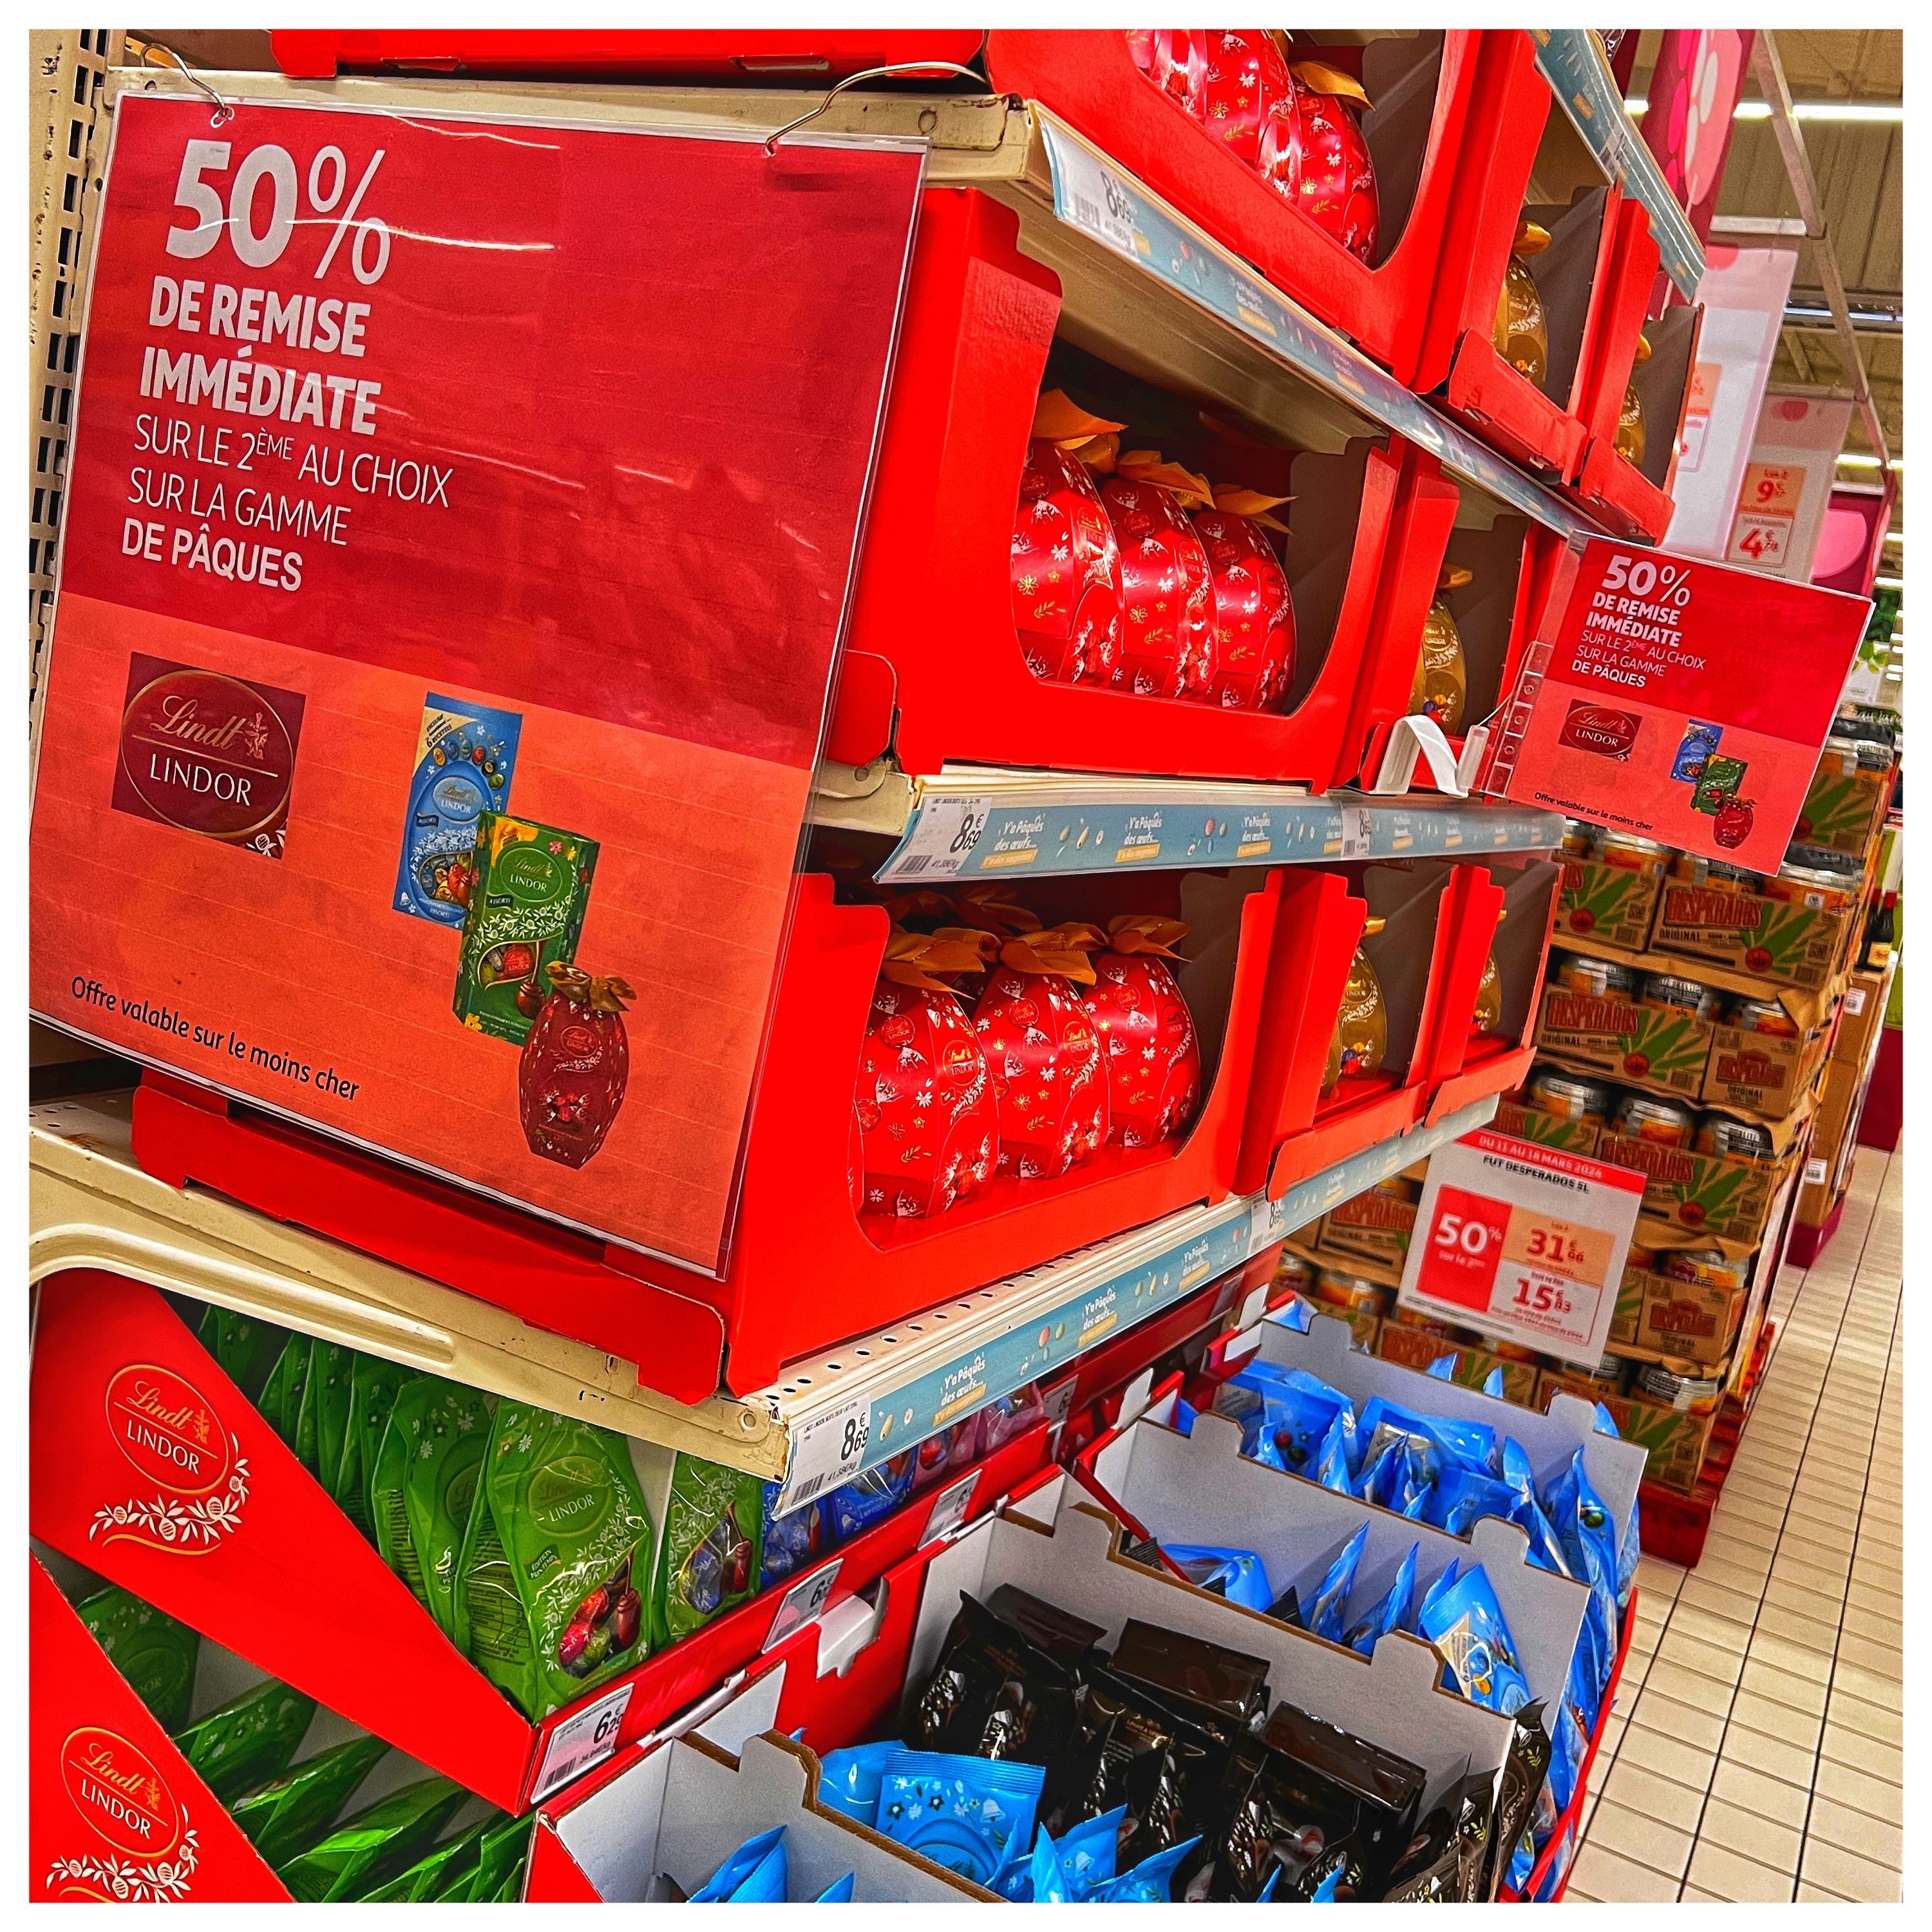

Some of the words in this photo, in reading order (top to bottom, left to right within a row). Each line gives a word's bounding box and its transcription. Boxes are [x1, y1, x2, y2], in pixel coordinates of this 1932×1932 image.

[166, 139, 391, 285] 50%
[149, 276, 201, 330] DE
[209, 284, 372, 357] REMISE
[140, 345, 382, 435] IMMÉDIATE
[134, 414, 191, 459] SUR
[197, 424, 232, 466] LE
[237, 428, 295, 471] 2ÈME
[298, 444, 345, 486] AU
[352, 453, 453, 507] CHOIX
[128, 467, 185, 512] SUR
[191, 478, 226, 521] LA
[235, 488, 352, 545] GAMME
[122, 517, 166, 561] DE
[171, 523, 303, 592] PÂQUES
[1602, 554, 1691, 606] 50%
[1593, 591, 1616, 610] DE
[1616, 597, 1680, 625] REMISE
[1586, 611, 1682, 647] IMMÉDIATE
[1577, 645, 1601, 661] SUR
[1602, 652, 1617, 665] LA
[1620, 656, 1667, 676] GAMME
[1581, 630, 1605, 645] SUR
[1607, 636, 1622, 650] LE
[1647, 647, 1666, 659] AU
[1667, 652, 1707, 670] CHOIX
[1572, 659, 1591, 674] DE
[1592, 664, 1646, 688] PÂQUES
[149, 696, 247, 750] Lindt
[1575, 729, 1618, 746] LINDOR
[1578, 712, 1618, 730] Lindt
[150, 753, 252, 806] LINDOR
[440, 799, 471, 814] LINDOR
[1534, 791, 1555, 804] Offre
[1556, 799, 1586, 812] valable
[1586, 808, 1600, 816] sur
[1601, 810, 1609, 819] le
[1609, 814, 1634, 826] moins
[1636, 821, 1653, 831] cher
[1016, 815, 1045, 836] Pâques
[994, 838, 1009, 851] des
[510, 874, 547, 893] LINDOR
[1659, 927, 1701, 943] ORIGINAL
[71, 976, 117, 1011] Offre
[121, 1000, 190, 1037] valable
[193, 1025, 225, 1050] sur
[228, 1032, 246, 1059] le
[249, 1048, 310, 1083] moins
[315, 1067, 360, 1101] cher
[888, 1029, 910, 1039] LINDOR
[951, 1065, 974, 1075] LINDOR
[1479, 1135, 1494, 1147] DU
[1509, 1143, 1526, 1157] AU
[1541, 1152, 1573, 1172] MARS
[1483, 1155, 1504, 1169] FUT
[1506, 1160, 1576, 1189] DESPERADOS
[945, 1374, 957, 1389] Y'a
[958, 1356, 985, 1383] Pâques
[126, 1381, 194, 1430] Lindt
[941, 1392, 956, 1406] des
[127, 1419, 200, 1475] LINDOR
[549, 1493, 595, 1522] LINDOR
[80, 1743, 146, 1795] Lindt
[80, 1778, 151, 1840] LINDOR
